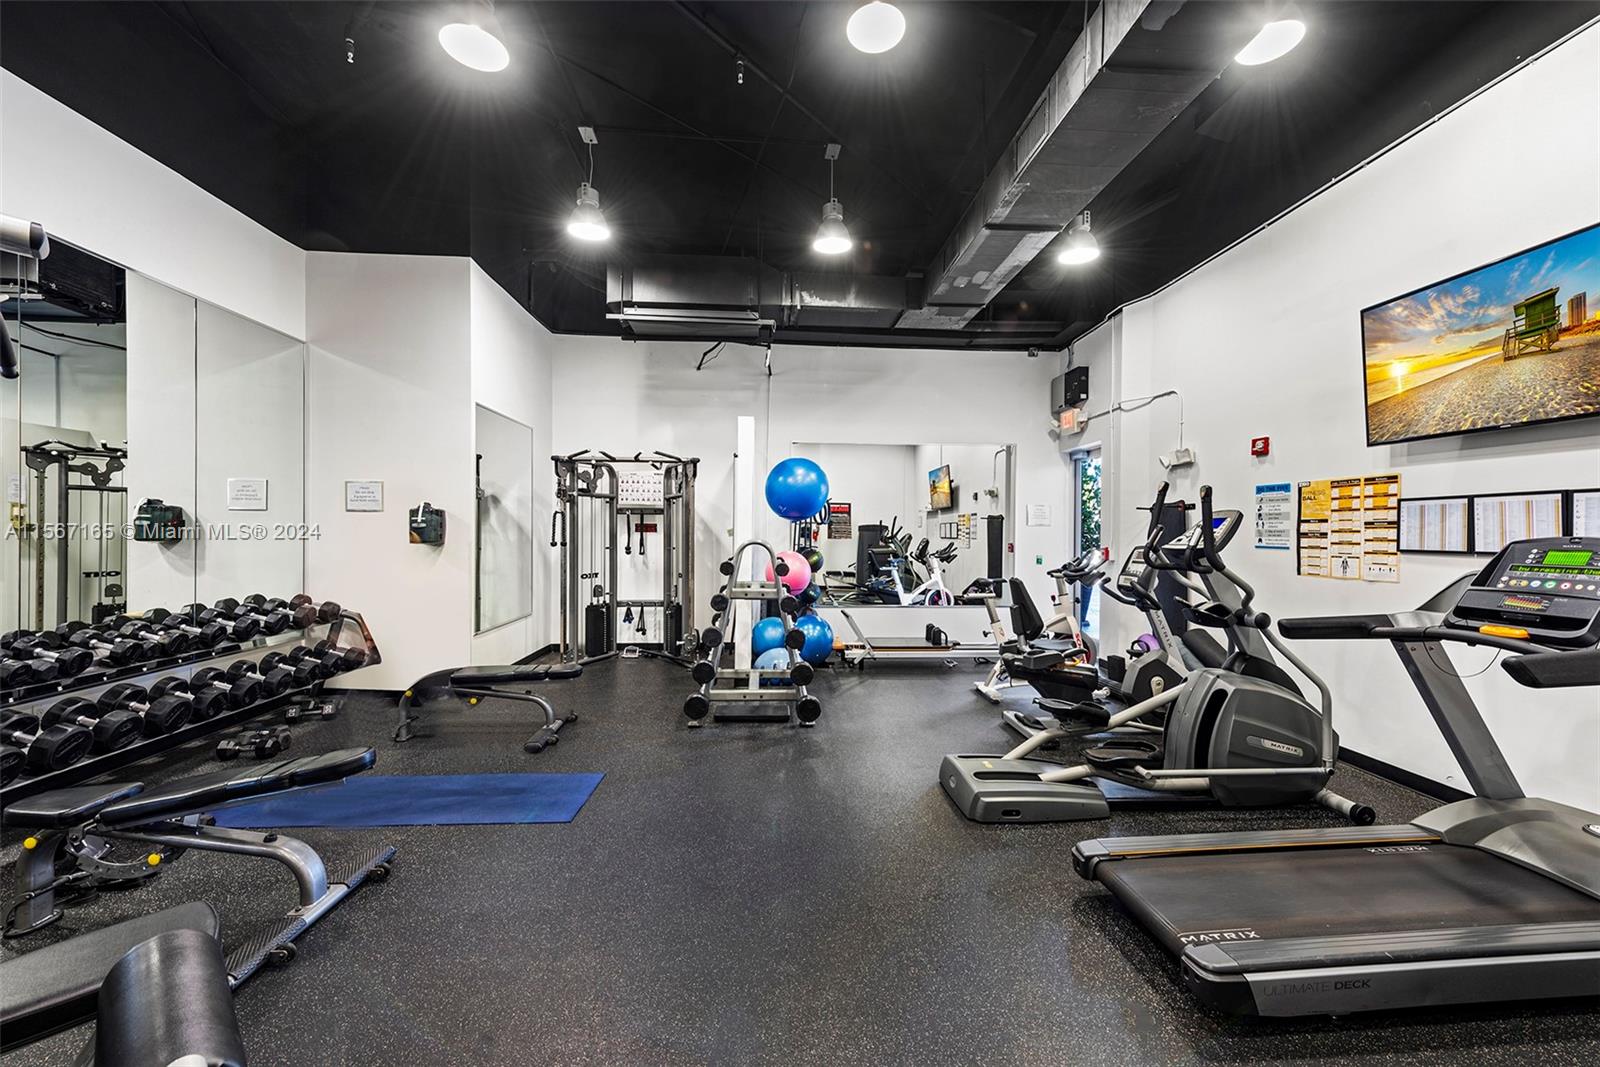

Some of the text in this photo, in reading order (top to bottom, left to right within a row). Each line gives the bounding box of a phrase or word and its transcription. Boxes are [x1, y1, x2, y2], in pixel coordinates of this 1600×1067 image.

[82, 570, 121, 578] TKO
[1154, 611, 1173, 648] MATRIX
[1270, 742, 1298, 753] MATRIX
[1180, 930, 1261, 944] MATRIX
[1263, 978, 1372, 997] ULTIMATE DECK
